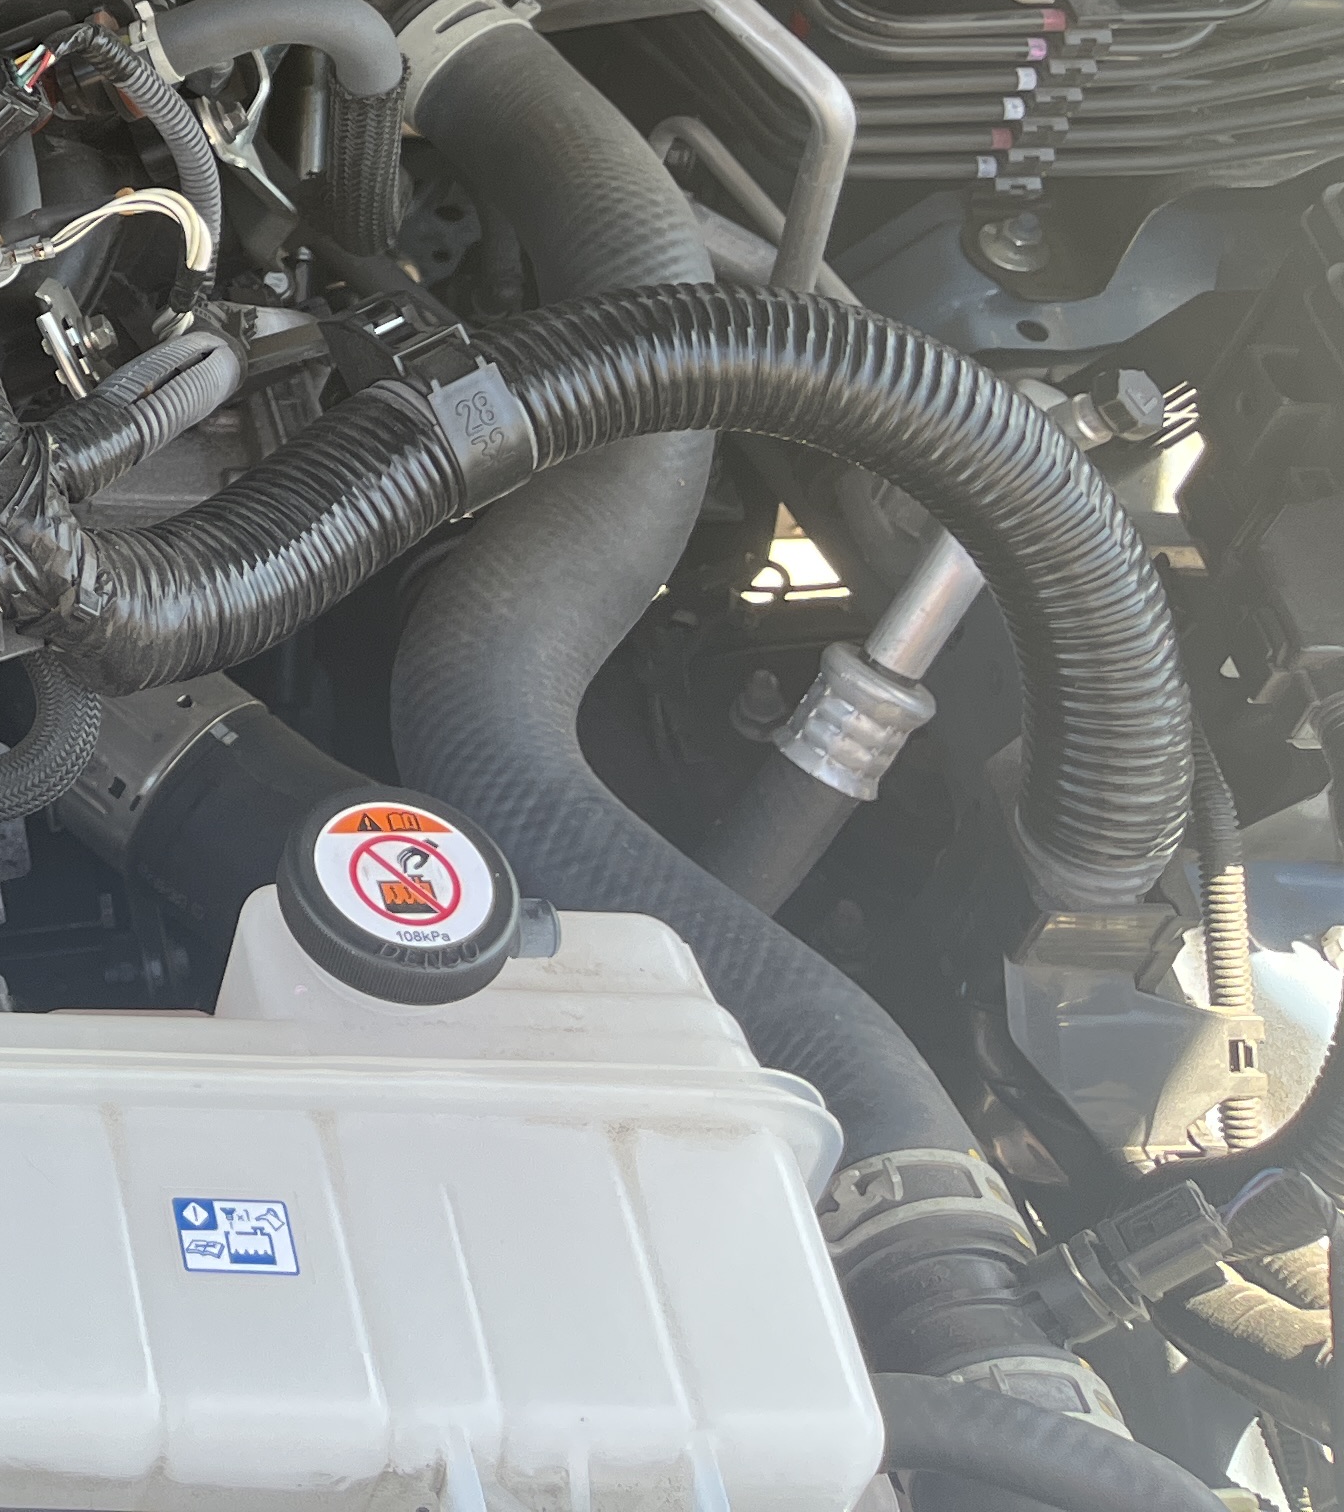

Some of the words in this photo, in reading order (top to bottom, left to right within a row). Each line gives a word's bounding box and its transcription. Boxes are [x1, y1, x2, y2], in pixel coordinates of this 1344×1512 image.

[455, 390, 498, 437] 28
[395, 930, 451, 943] 108kPa
[378, 941, 480, 972] DENSO
